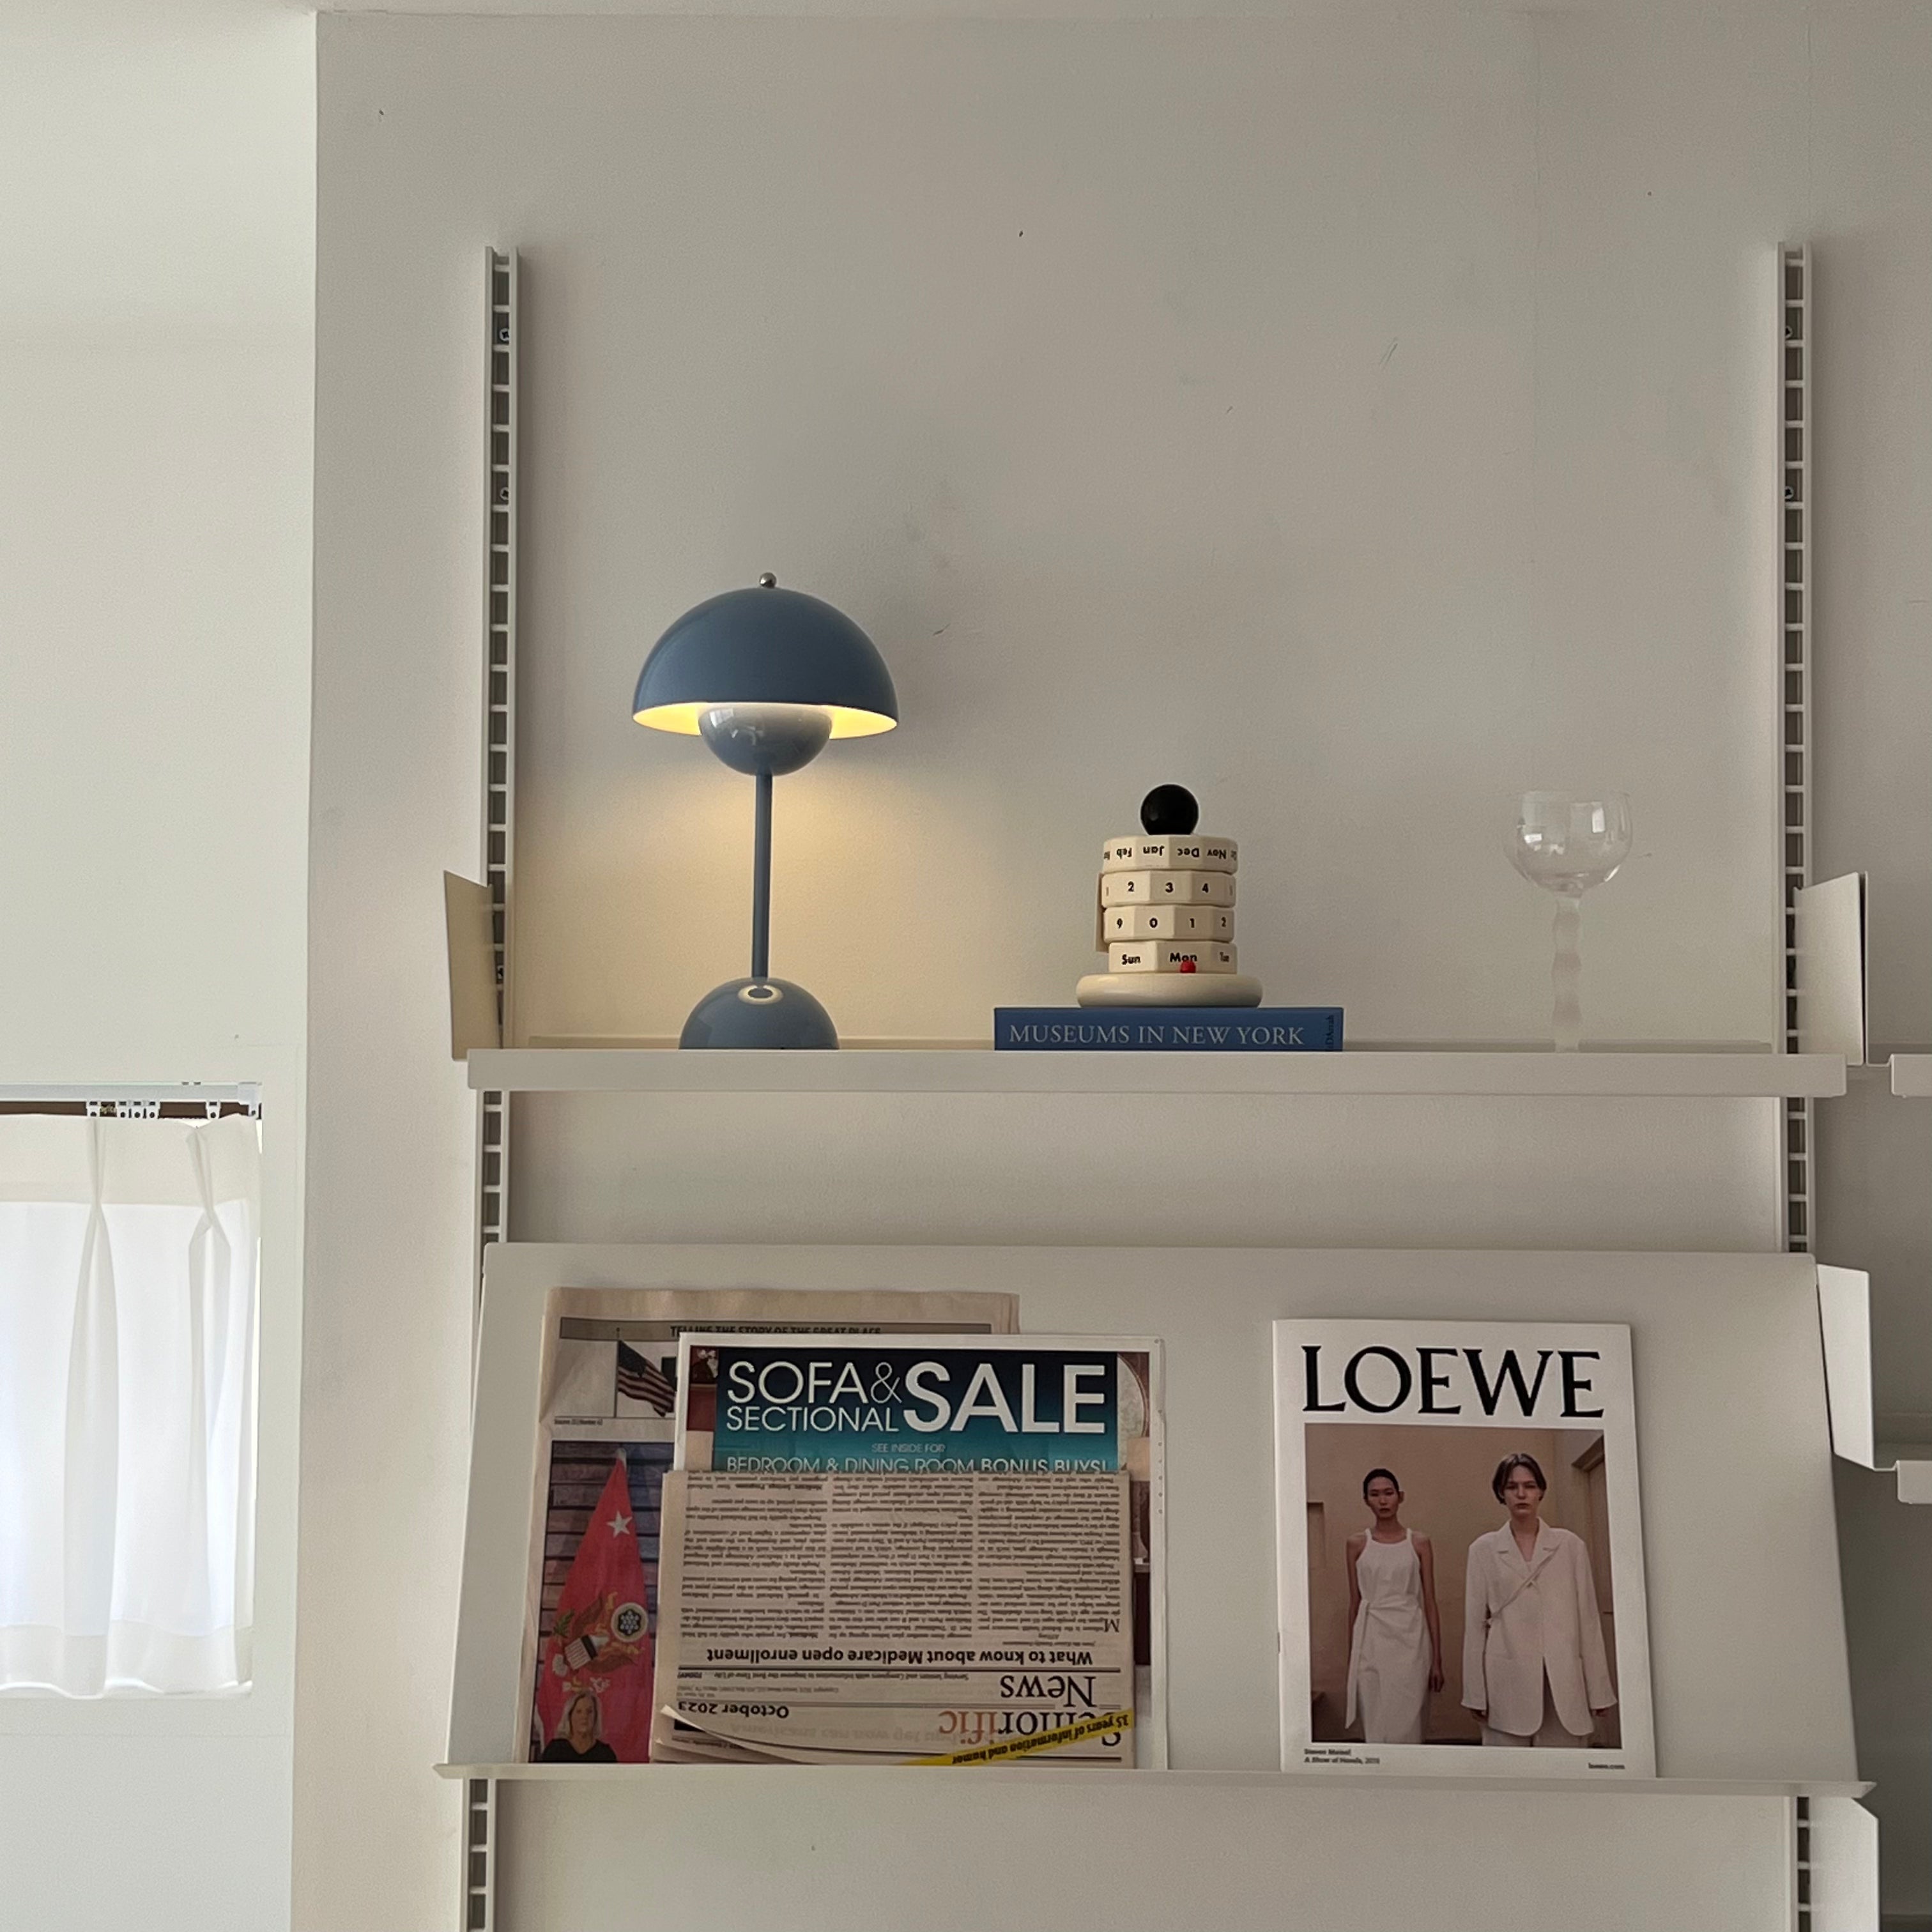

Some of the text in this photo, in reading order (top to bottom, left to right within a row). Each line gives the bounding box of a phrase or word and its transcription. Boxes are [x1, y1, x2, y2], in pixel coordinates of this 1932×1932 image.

[1116, 848, 1132, 859] Feb
[1143, 846, 1164, 856] Jan
[1177, 848, 1200, 857] Dec
[1207, 849, 1227, 859] Nov
[1128, 881, 1135, 893] 2
[1165, 882, 1174, 893] 3
[1202, 883, 1209, 893] 4
[1116, 917, 1227, 929] 9 0 1 2
[1121, 954, 1141, 965] Sun
[1170, 953, 1198, 963] Mon
[1009, 1025, 1305, 1045] MUSEUMS IN NEW YORK
[1301, 1345, 1604, 1418] LOEWE
[904, 1361, 1106, 1434] SALE
[726, 1406, 899, 1432] SECTIONAL
[871, 1443, 946, 1453] SEE INSIDE FOR
[726, 1457, 820, 1472] BEDROOM
[826, 1457, 839, 1471] &
[845, 1458, 909, 1473] DINING
[915, 1458, 974, 1473] ROOM
[981, 1458, 1049, 1473] BONUS
[707, 1646, 1093, 1666] What to know about Medicare open enrollment
[999, 1675, 1097, 1707] News
[678, 1701, 789, 1719] October 2023
[951, 1714, 1129, 1765] 35 years of information and humor
